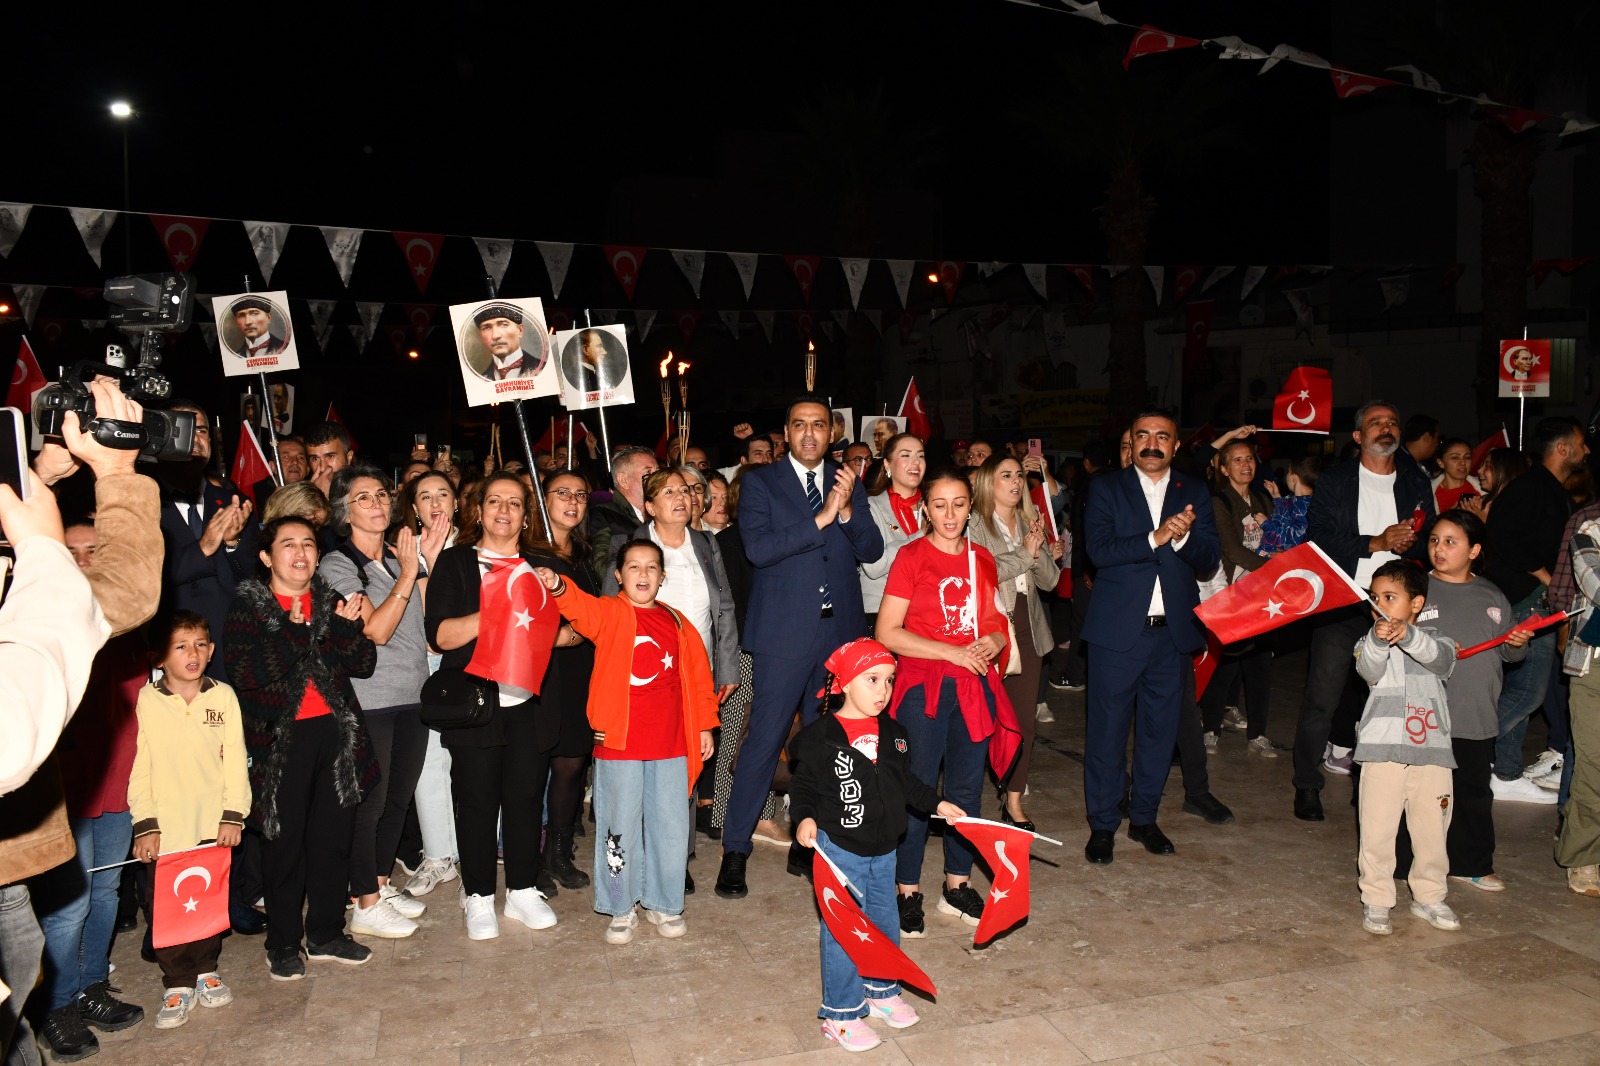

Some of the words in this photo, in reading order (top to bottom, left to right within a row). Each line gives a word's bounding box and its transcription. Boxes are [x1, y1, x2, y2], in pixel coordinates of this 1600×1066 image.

[495, 379, 534, 389] CUMHURİYET
[495, 384, 535, 394] BAYRAMIMIZ
[113, 430, 140, 438] Canon
[1405, 703, 1426, 716] the
